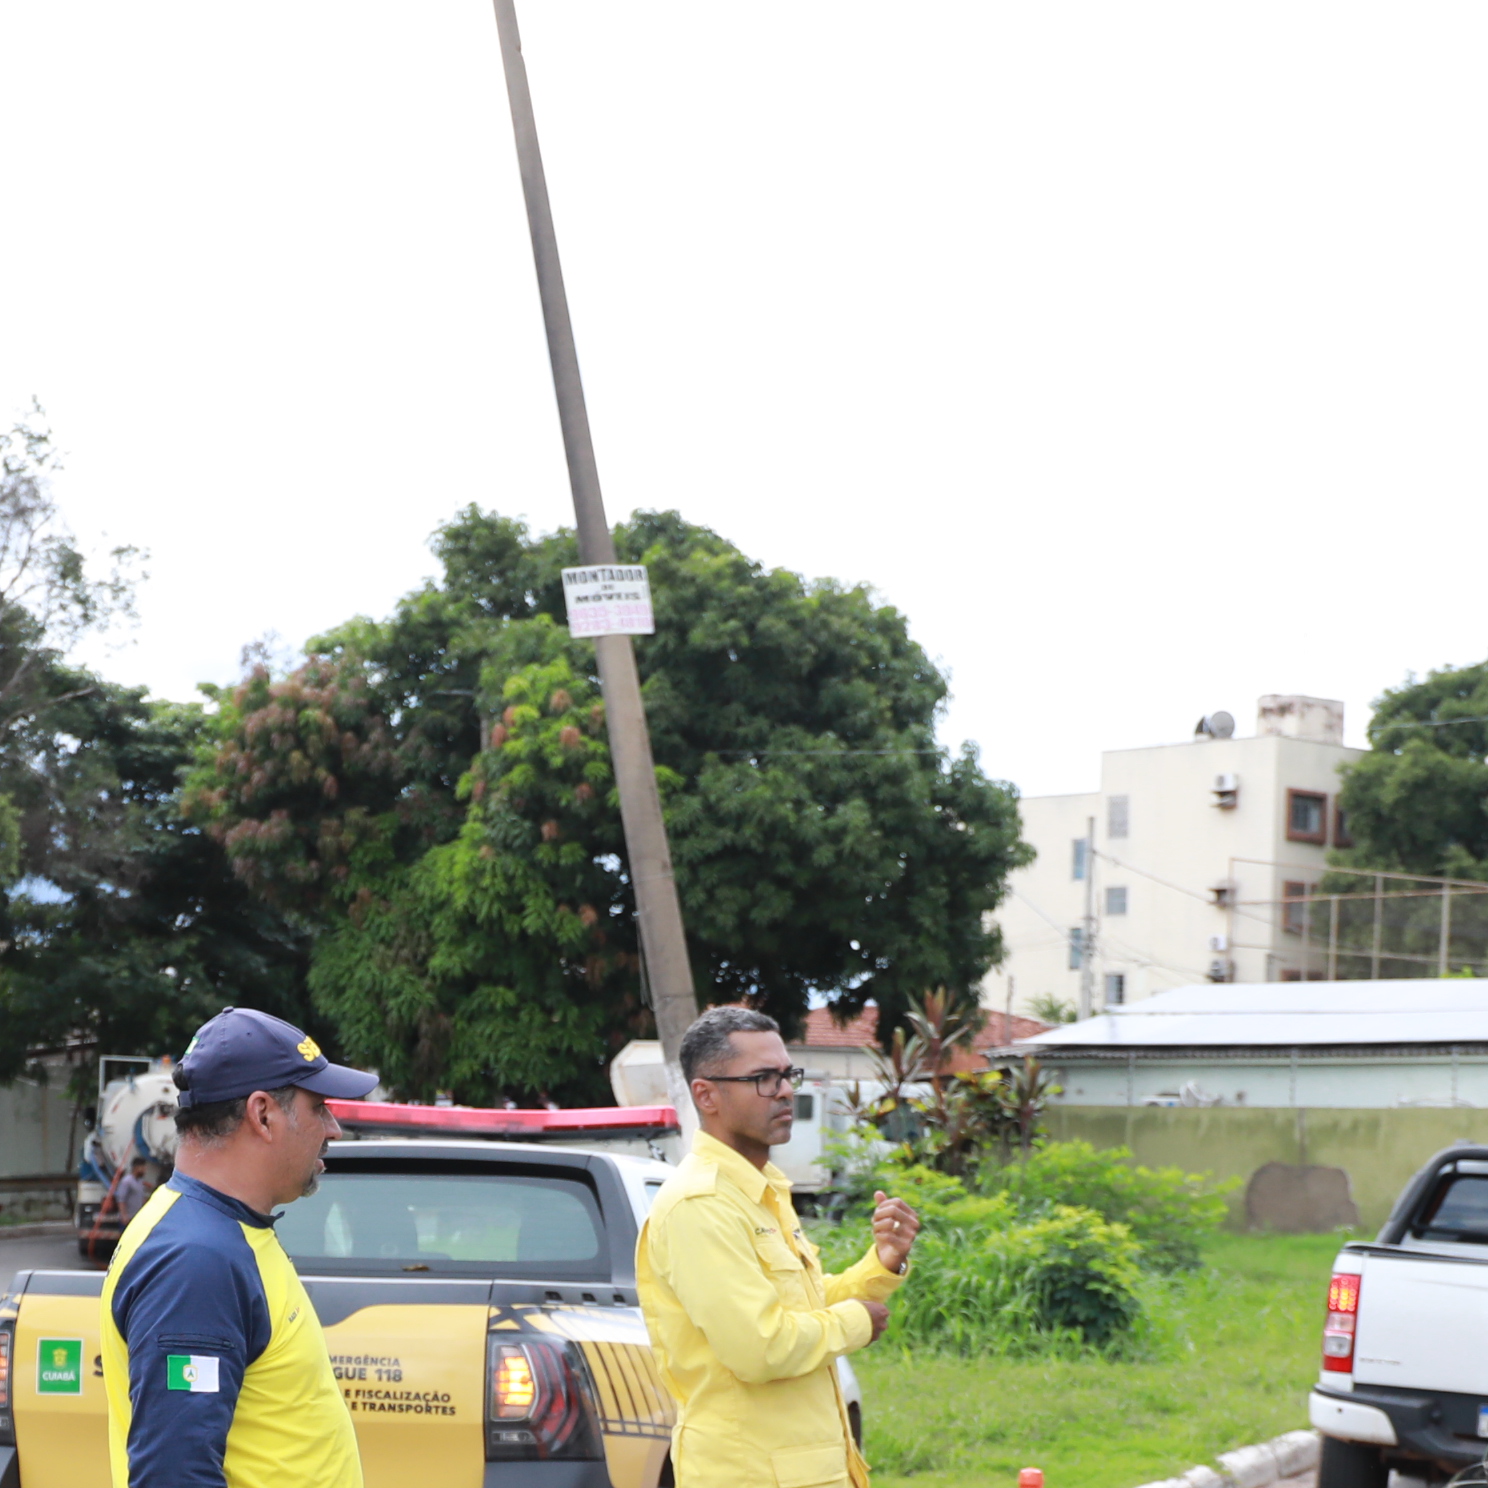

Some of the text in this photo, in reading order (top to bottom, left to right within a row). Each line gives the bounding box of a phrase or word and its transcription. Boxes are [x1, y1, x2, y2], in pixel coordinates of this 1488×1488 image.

[565, 569, 643, 585] MONTADOR
[328, 1355, 400, 1367] MERGÊNCIA
[41, 1369, 76, 1382] CUIABÁ
[333, 1366, 403, 1383] GUE 118
[355, 1389, 451, 1404] FISCALIZAÇÃO
[352, 1401, 456, 1416] E TRANSPORTES
